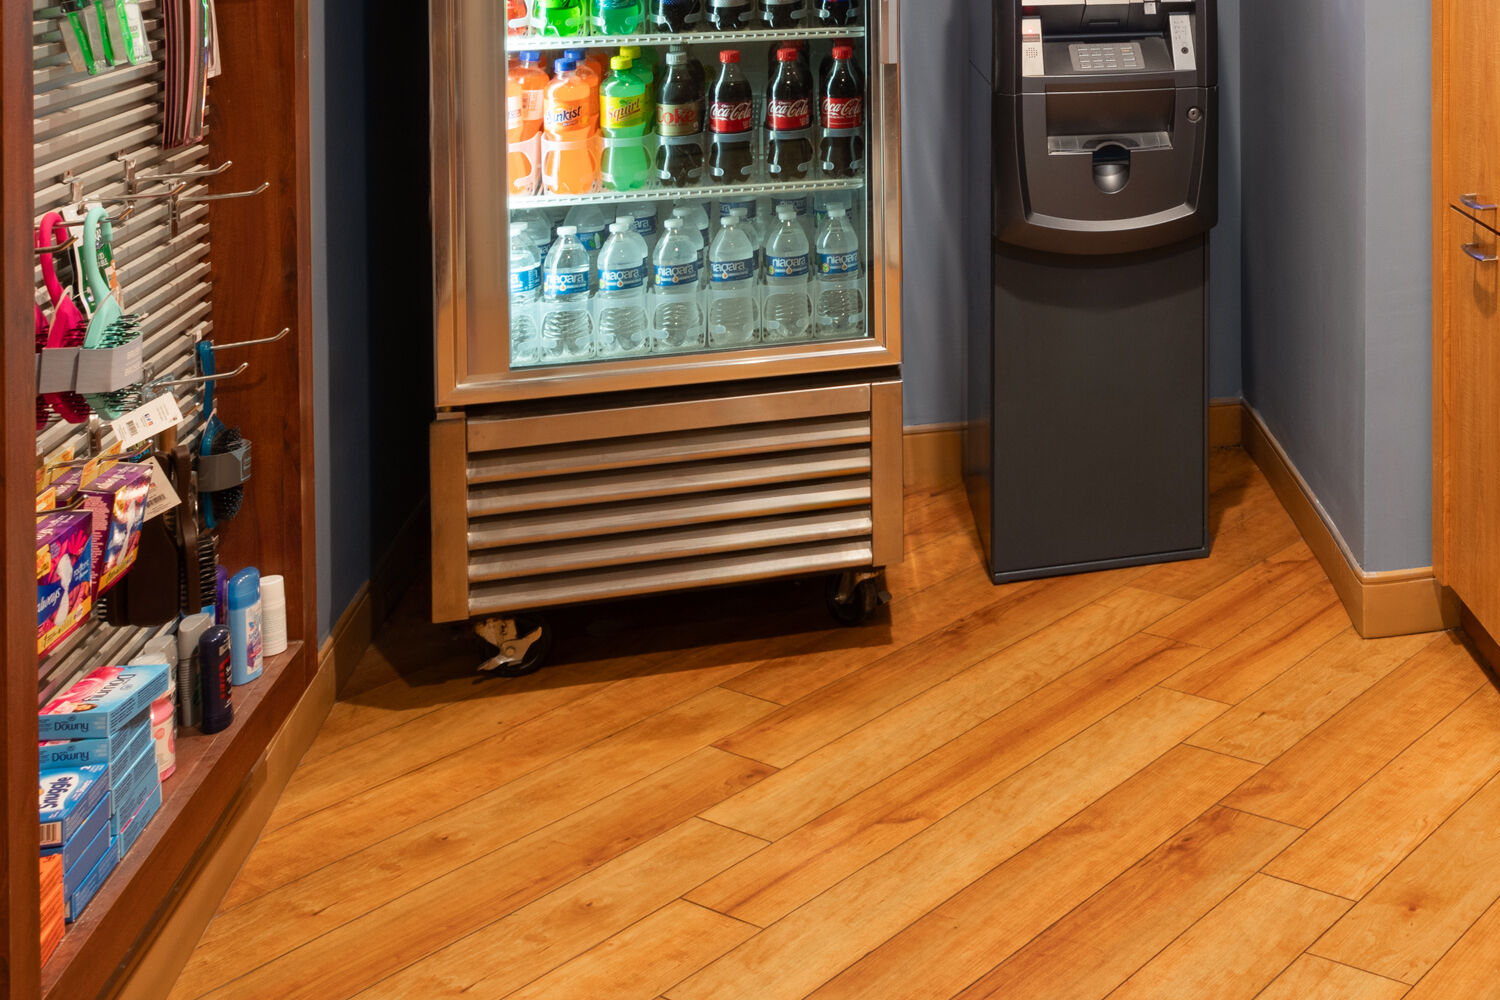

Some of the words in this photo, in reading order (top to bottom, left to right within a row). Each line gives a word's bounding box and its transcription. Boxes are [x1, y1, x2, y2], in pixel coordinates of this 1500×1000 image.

[607, 97, 641, 121] Squirt
[656, 104, 696, 124] Coke
[772, 255, 806, 268] niagara
[602, 268, 640, 282] niagara
[657, 263, 695, 277] niagara
[54, 721, 90, 733] Downy
[52, 750, 90, 763] Downy
